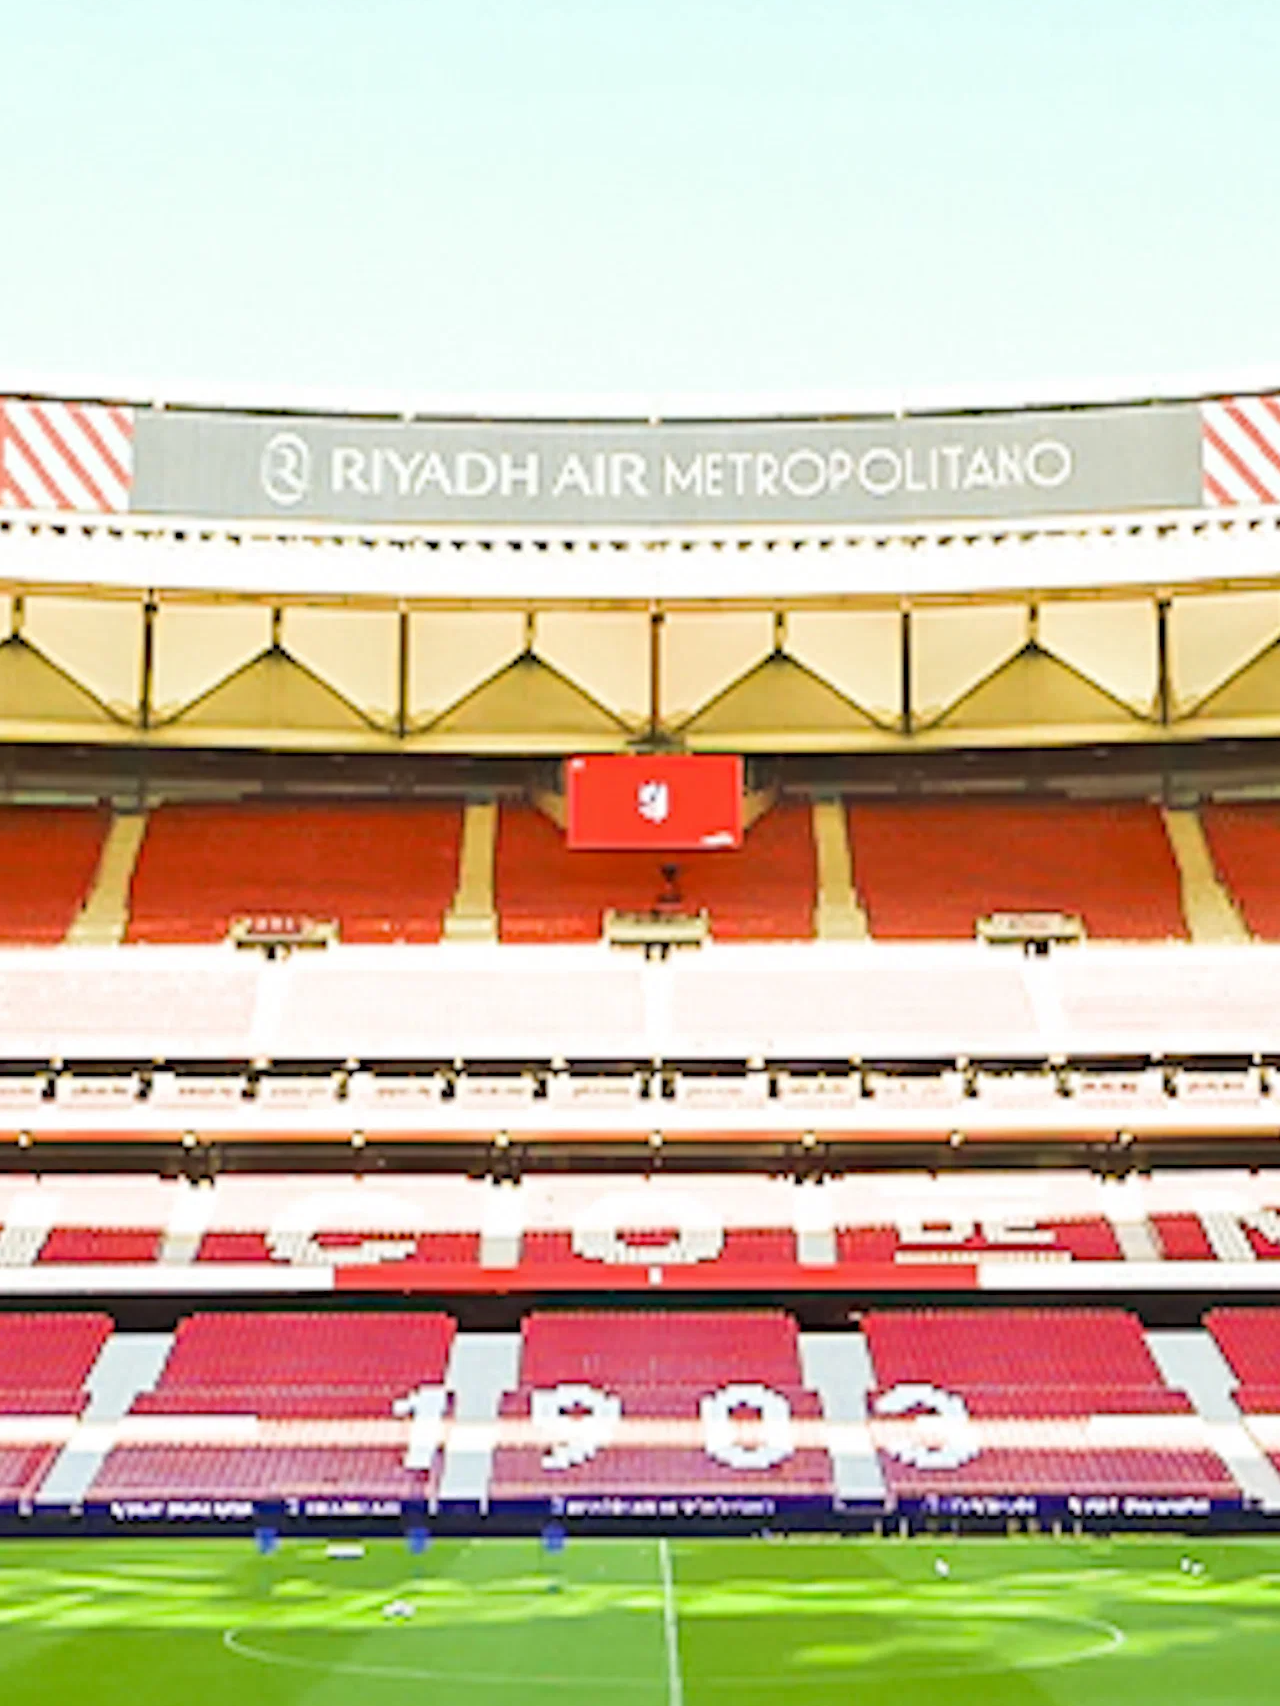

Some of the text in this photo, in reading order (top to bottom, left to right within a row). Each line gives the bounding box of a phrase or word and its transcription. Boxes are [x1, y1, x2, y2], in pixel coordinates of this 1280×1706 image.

[331, 440, 1072, 497] RIYADH AIR METROPOLITANO
[392, 1382, 986, 1470] 1903
